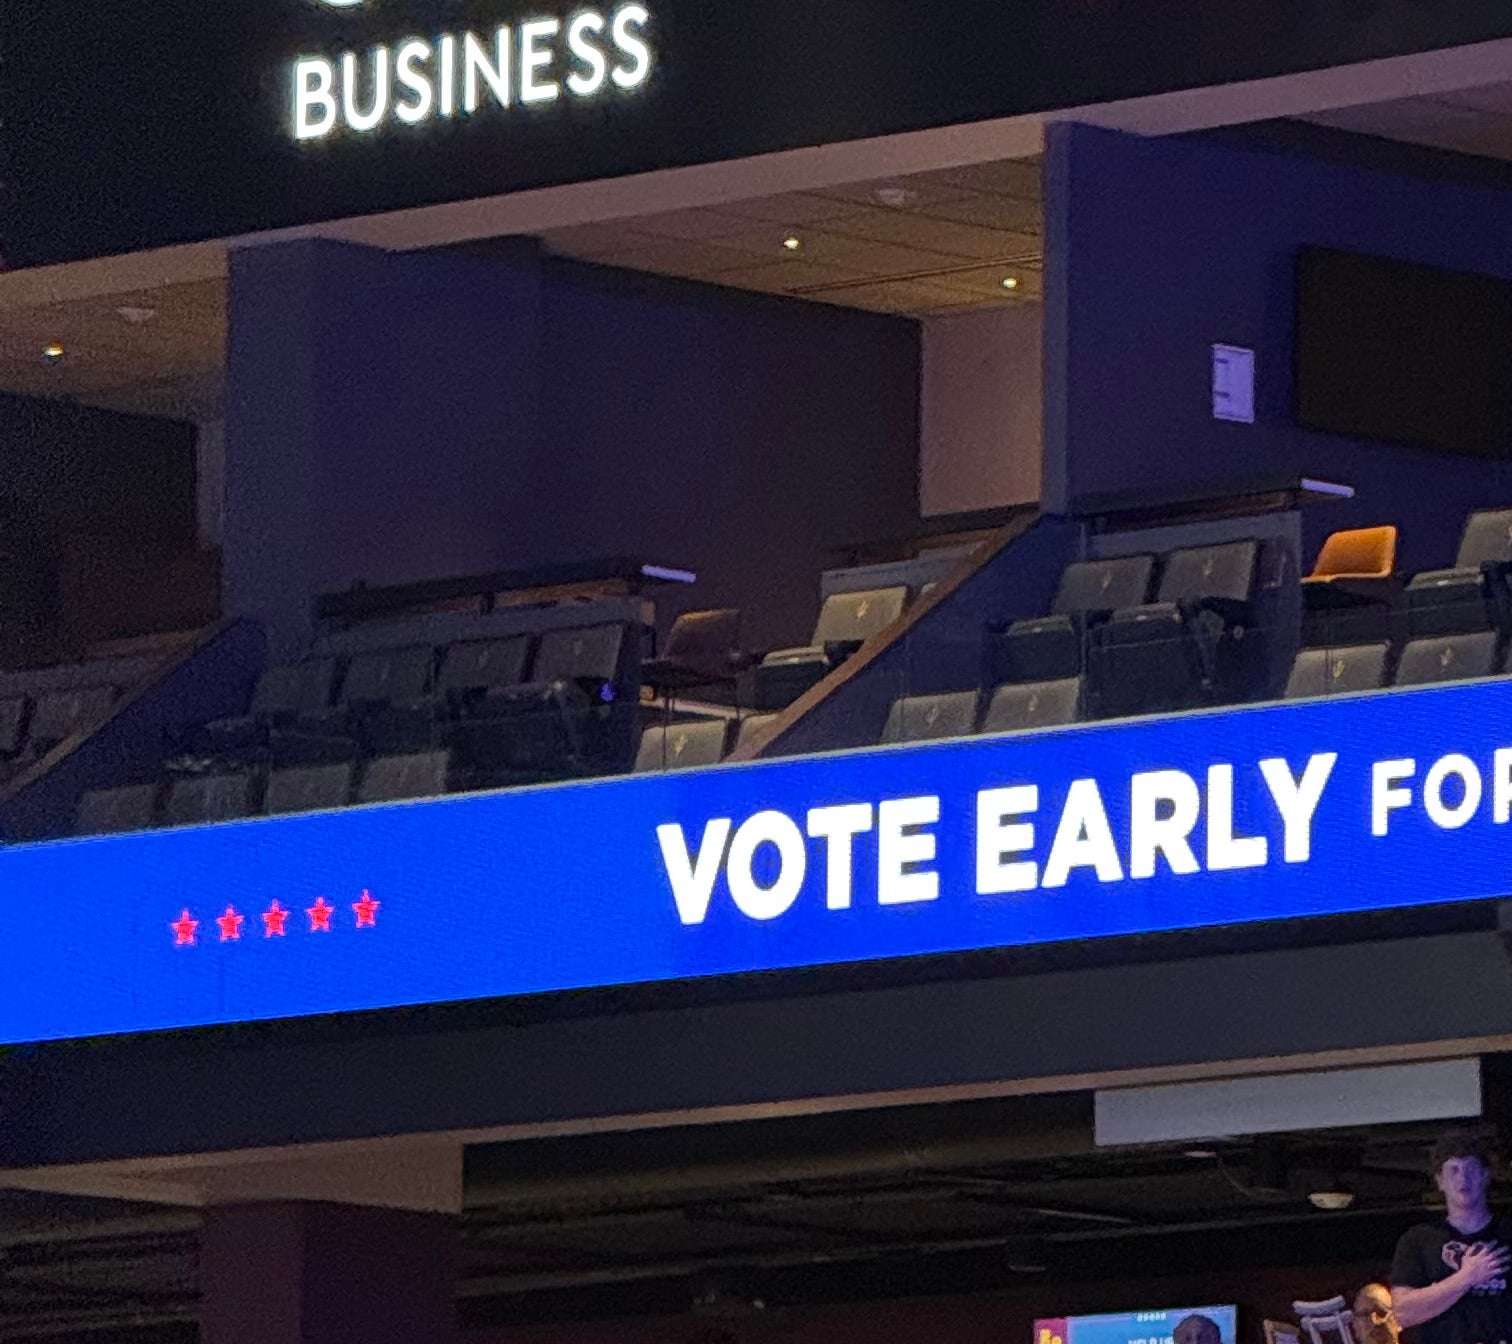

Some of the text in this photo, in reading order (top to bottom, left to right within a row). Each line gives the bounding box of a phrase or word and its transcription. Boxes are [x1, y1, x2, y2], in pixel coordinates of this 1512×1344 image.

[293, 3, 651, 140] BUSINESS
[657, 796, 939, 924] VOTE
[976, 753, 1337, 894] EARLY
